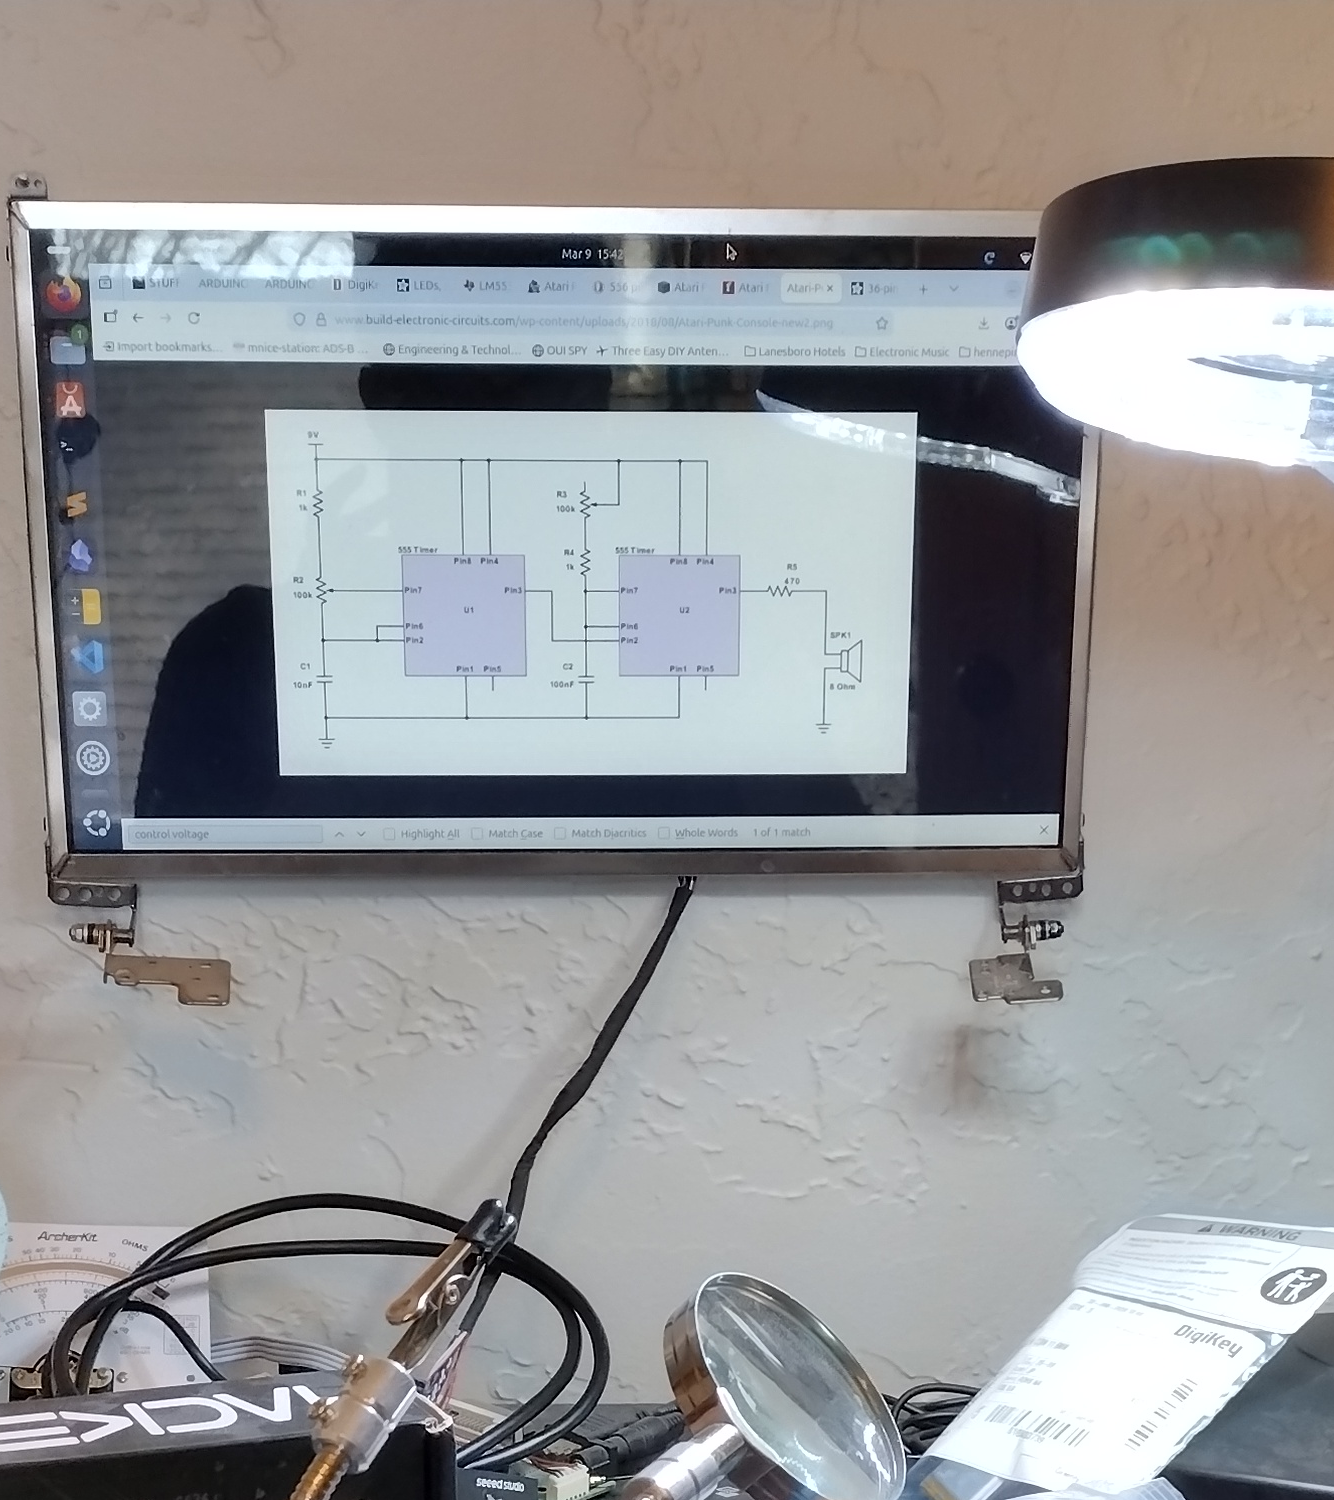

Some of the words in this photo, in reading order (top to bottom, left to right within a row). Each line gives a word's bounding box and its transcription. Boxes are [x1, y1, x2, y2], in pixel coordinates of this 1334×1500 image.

[562, 249, 583, 260] Mar
[585, 249, 592, 260] 9
[598, 249, 624, 260] 15:42
[544, 281, 568, 291] Atari
[674, 283, 699, 292] Atari
[738, 283, 763, 292] Atari
[118, 342, 152, 353] Import
[323, 343, 354, 353] ADS-B
[398, 344, 458, 357] Engineering
[461, 344, 469, 354] &
[547, 346, 566, 355] OUI
[567, 346, 588, 355] SPY
[612, 346, 641, 356] Three
[643, 346, 666, 358] Easy
[668, 347, 685, 356] DIY
[759, 347, 811, 357] Lanesboro
[813, 347, 846, 357] Hotels
[870, 347, 921, 357] Electronic
[923, 347, 949, 357] Music
[556, 491, 567, 499] R3
[556, 505, 576, 513] 100k
[398, 546, 412, 554] 555
[414, 546, 438, 554] Timer
[631, 546, 655, 554] Timer
[454, 557, 472, 565] Pin8
[480, 557, 499, 565] Pin4
[670, 558, 688, 566] Pin8
[696, 558, 715, 566] Pin4
[566, 563, 575, 571] 1k
[404, 586, 422, 595] Pin7
[504, 586, 523, 594] Pin3
[620, 587, 639, 595] Pin7
[719, 587, 737, 595] Pin3
[293, 591, 313, 599] 100k
[464, 606, 474, 614] U1
[679, 606, 690, 614] U2
[405, 622, 424, 630] Pin6
[620, 622, 639, 631] Pin6
[405, 636, 424, 644] Pin2
[620, 636, 639, 645] Pin2
[830, 632, 851, 640] SPK1
[456, 665, 474, 673] Pin1
[483, 665, 501, 673] Pin5
[669, 665, 687, 673] Pin1
[696, 665, 715, 673] Pin5
[293, 681, 313, 689] 10nF
[837, 683, 856, 691] Ohm
[135, 828, 170, 840] control
[172, 829, 210, 842] voltage
[401, 828, 445, 841] Highlight
[447, 828, 460, 841] All
[489, 828, 517, 839] Match
[520, 828, 543, 840] Case
[571, 827, 603, 838] Match
[608, 827, 647, 840] Diacritics
[675, 827, 705, 840] Whole
[707, 827, 739, 838] Words
[753, 827, 758, 838] 1
[760, 827, 771, 838] of
[774, 827, 779, 838] 1
[781, 827, 811, 838] match
[37, 1231, 98, 1243] ArcherKit
[1218, 1225, 1302, 1242] WARNING
[121, 1238, 149, 1253] OHMS
[1173, 1324, 1243, 1358] DigiKey
[476, 1478, 503, 1490] seeed
